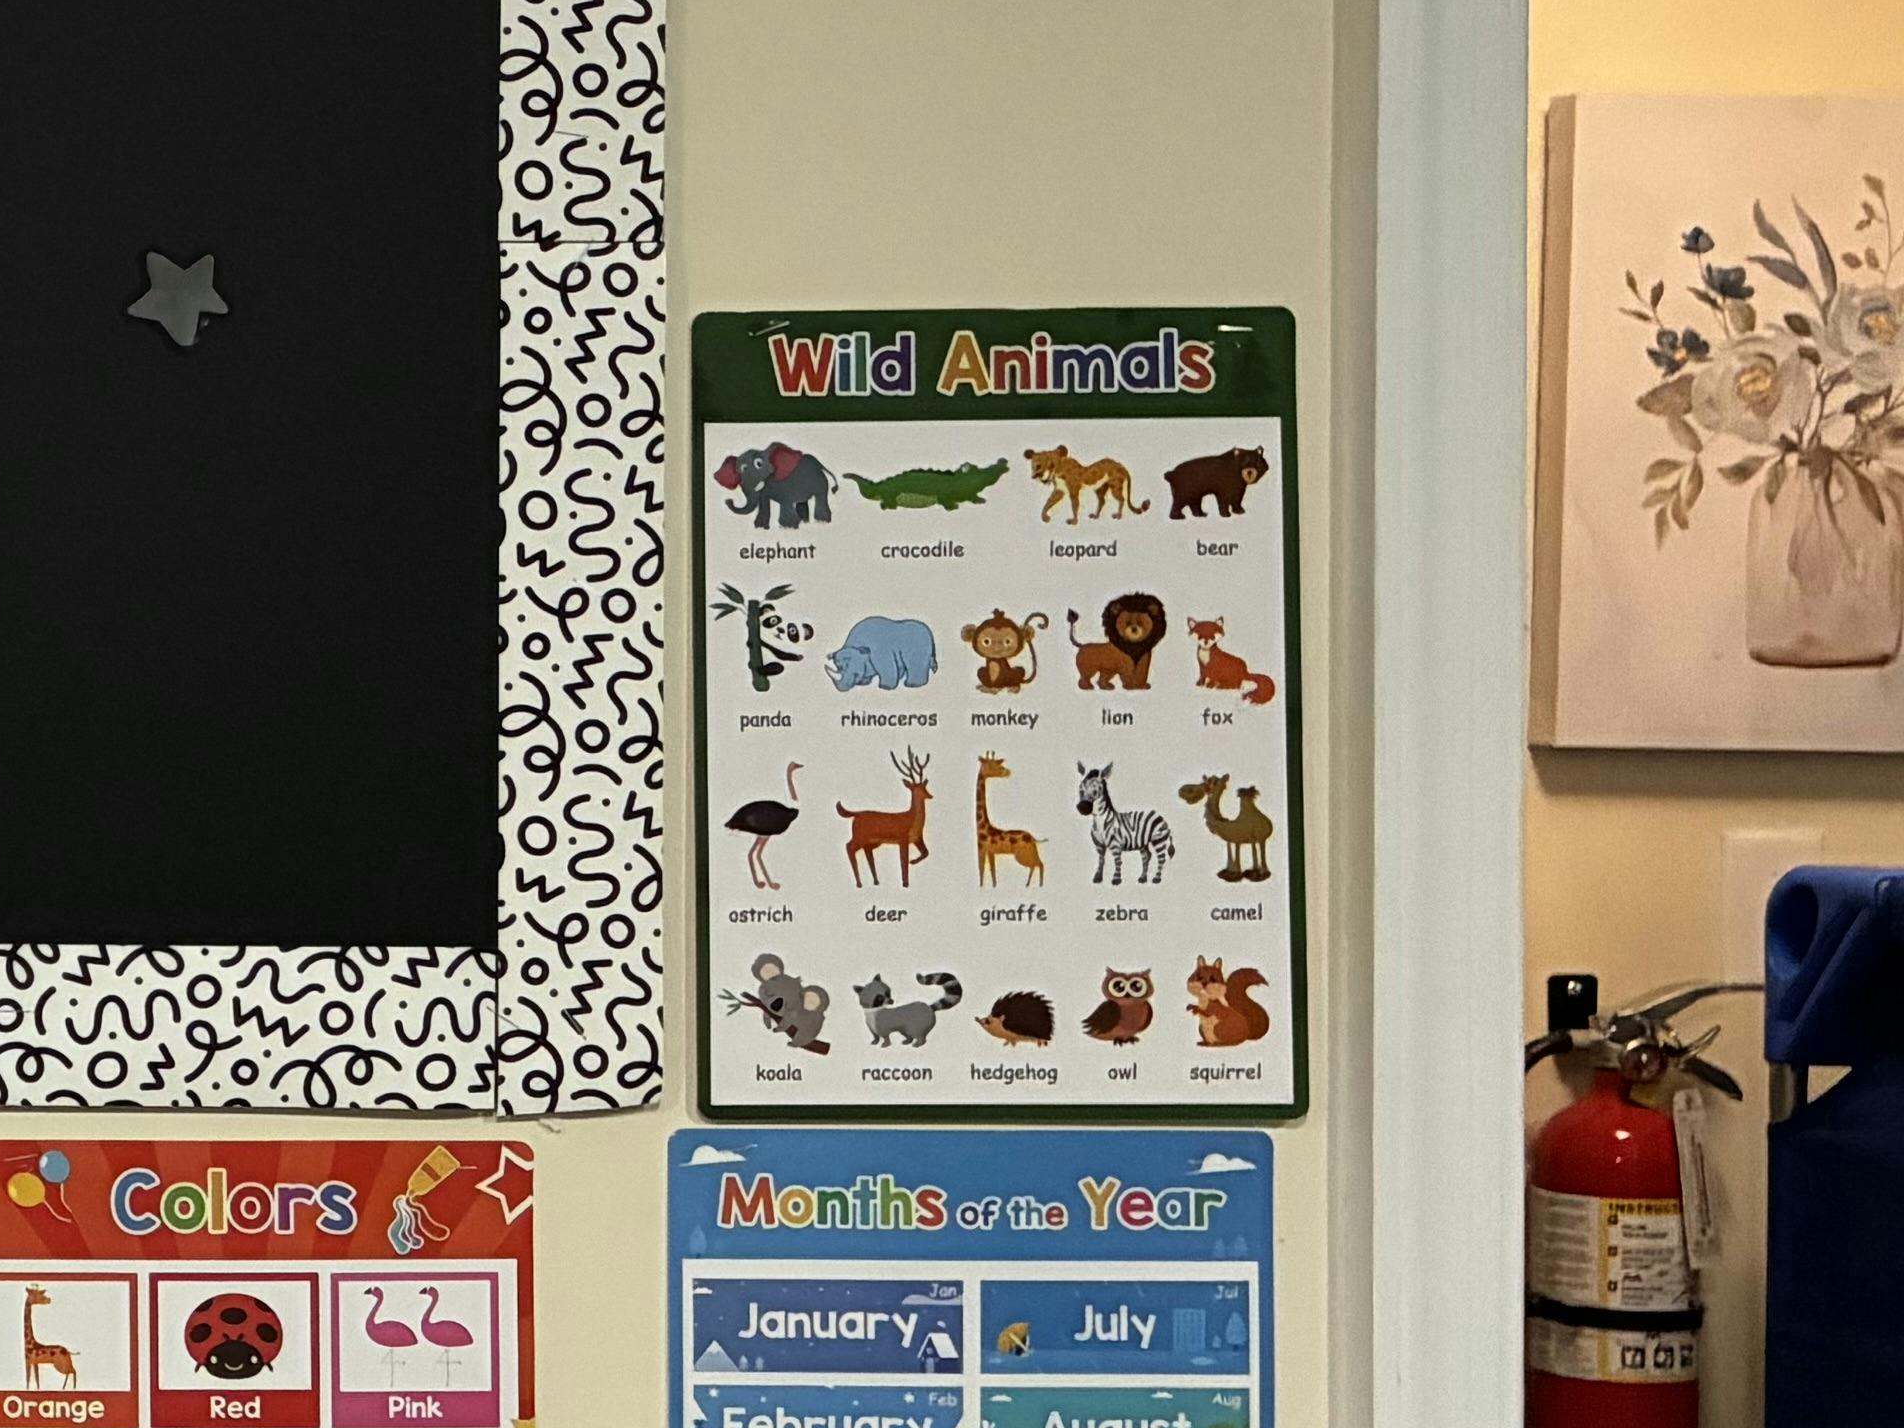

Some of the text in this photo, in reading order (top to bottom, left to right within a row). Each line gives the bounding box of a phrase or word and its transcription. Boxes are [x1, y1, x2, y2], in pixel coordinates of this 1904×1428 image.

[768, 328, 1215, 396] Wild Animals
[739, 541, 816, 561] elephant
[1095, 904, 1148, 922] zebra
[970, 1064, 1058, 1084] hedgehog
[1190, 1063, 1262, 1083] squirrel
[110, 1167, 358, 1236] Colors
[717, 1172, 1226, 1232] Months of the Year
[738, 1302, 918, 1348] January
[1074, 1304, 1156, 1350] July
[2, 1396, 105, 1421] Orange
[209, 1396, 261, 1419] Red
[387, 1396, 443, 1419] Pink
